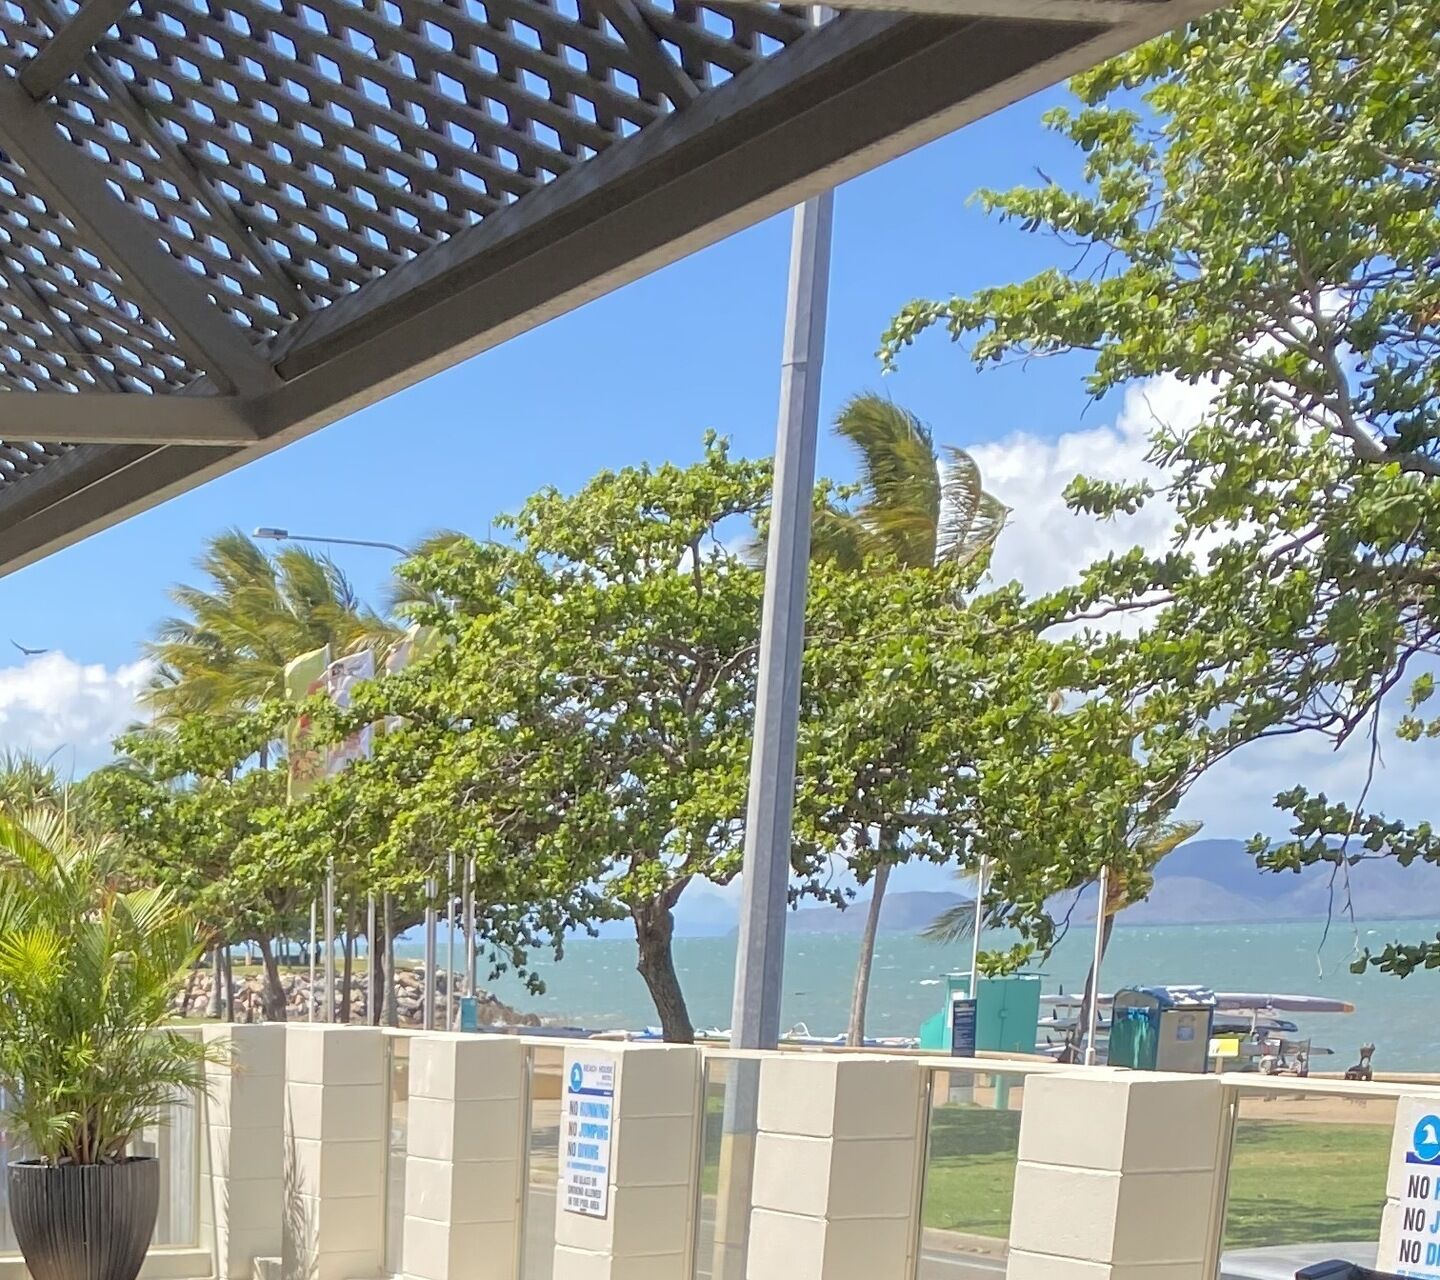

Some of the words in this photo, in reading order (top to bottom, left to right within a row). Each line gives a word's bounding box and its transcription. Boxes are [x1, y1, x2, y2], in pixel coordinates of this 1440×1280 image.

[569, 1100, 578, 1116] NO
[580, 1102, 609, 1119] RUNNING
[568, 1121, 577, 1136] NO
[578, 1122, 608, 1140] JUMPING
[567, 1141, 576, 1156] NO
[578, 1143, 599, 1160] DIVING
[1408, 1174, 1430, 1199] NO
[1403, 1207, 1426, 1232] NO
[1399, 1239, 1421, 1263] NO
